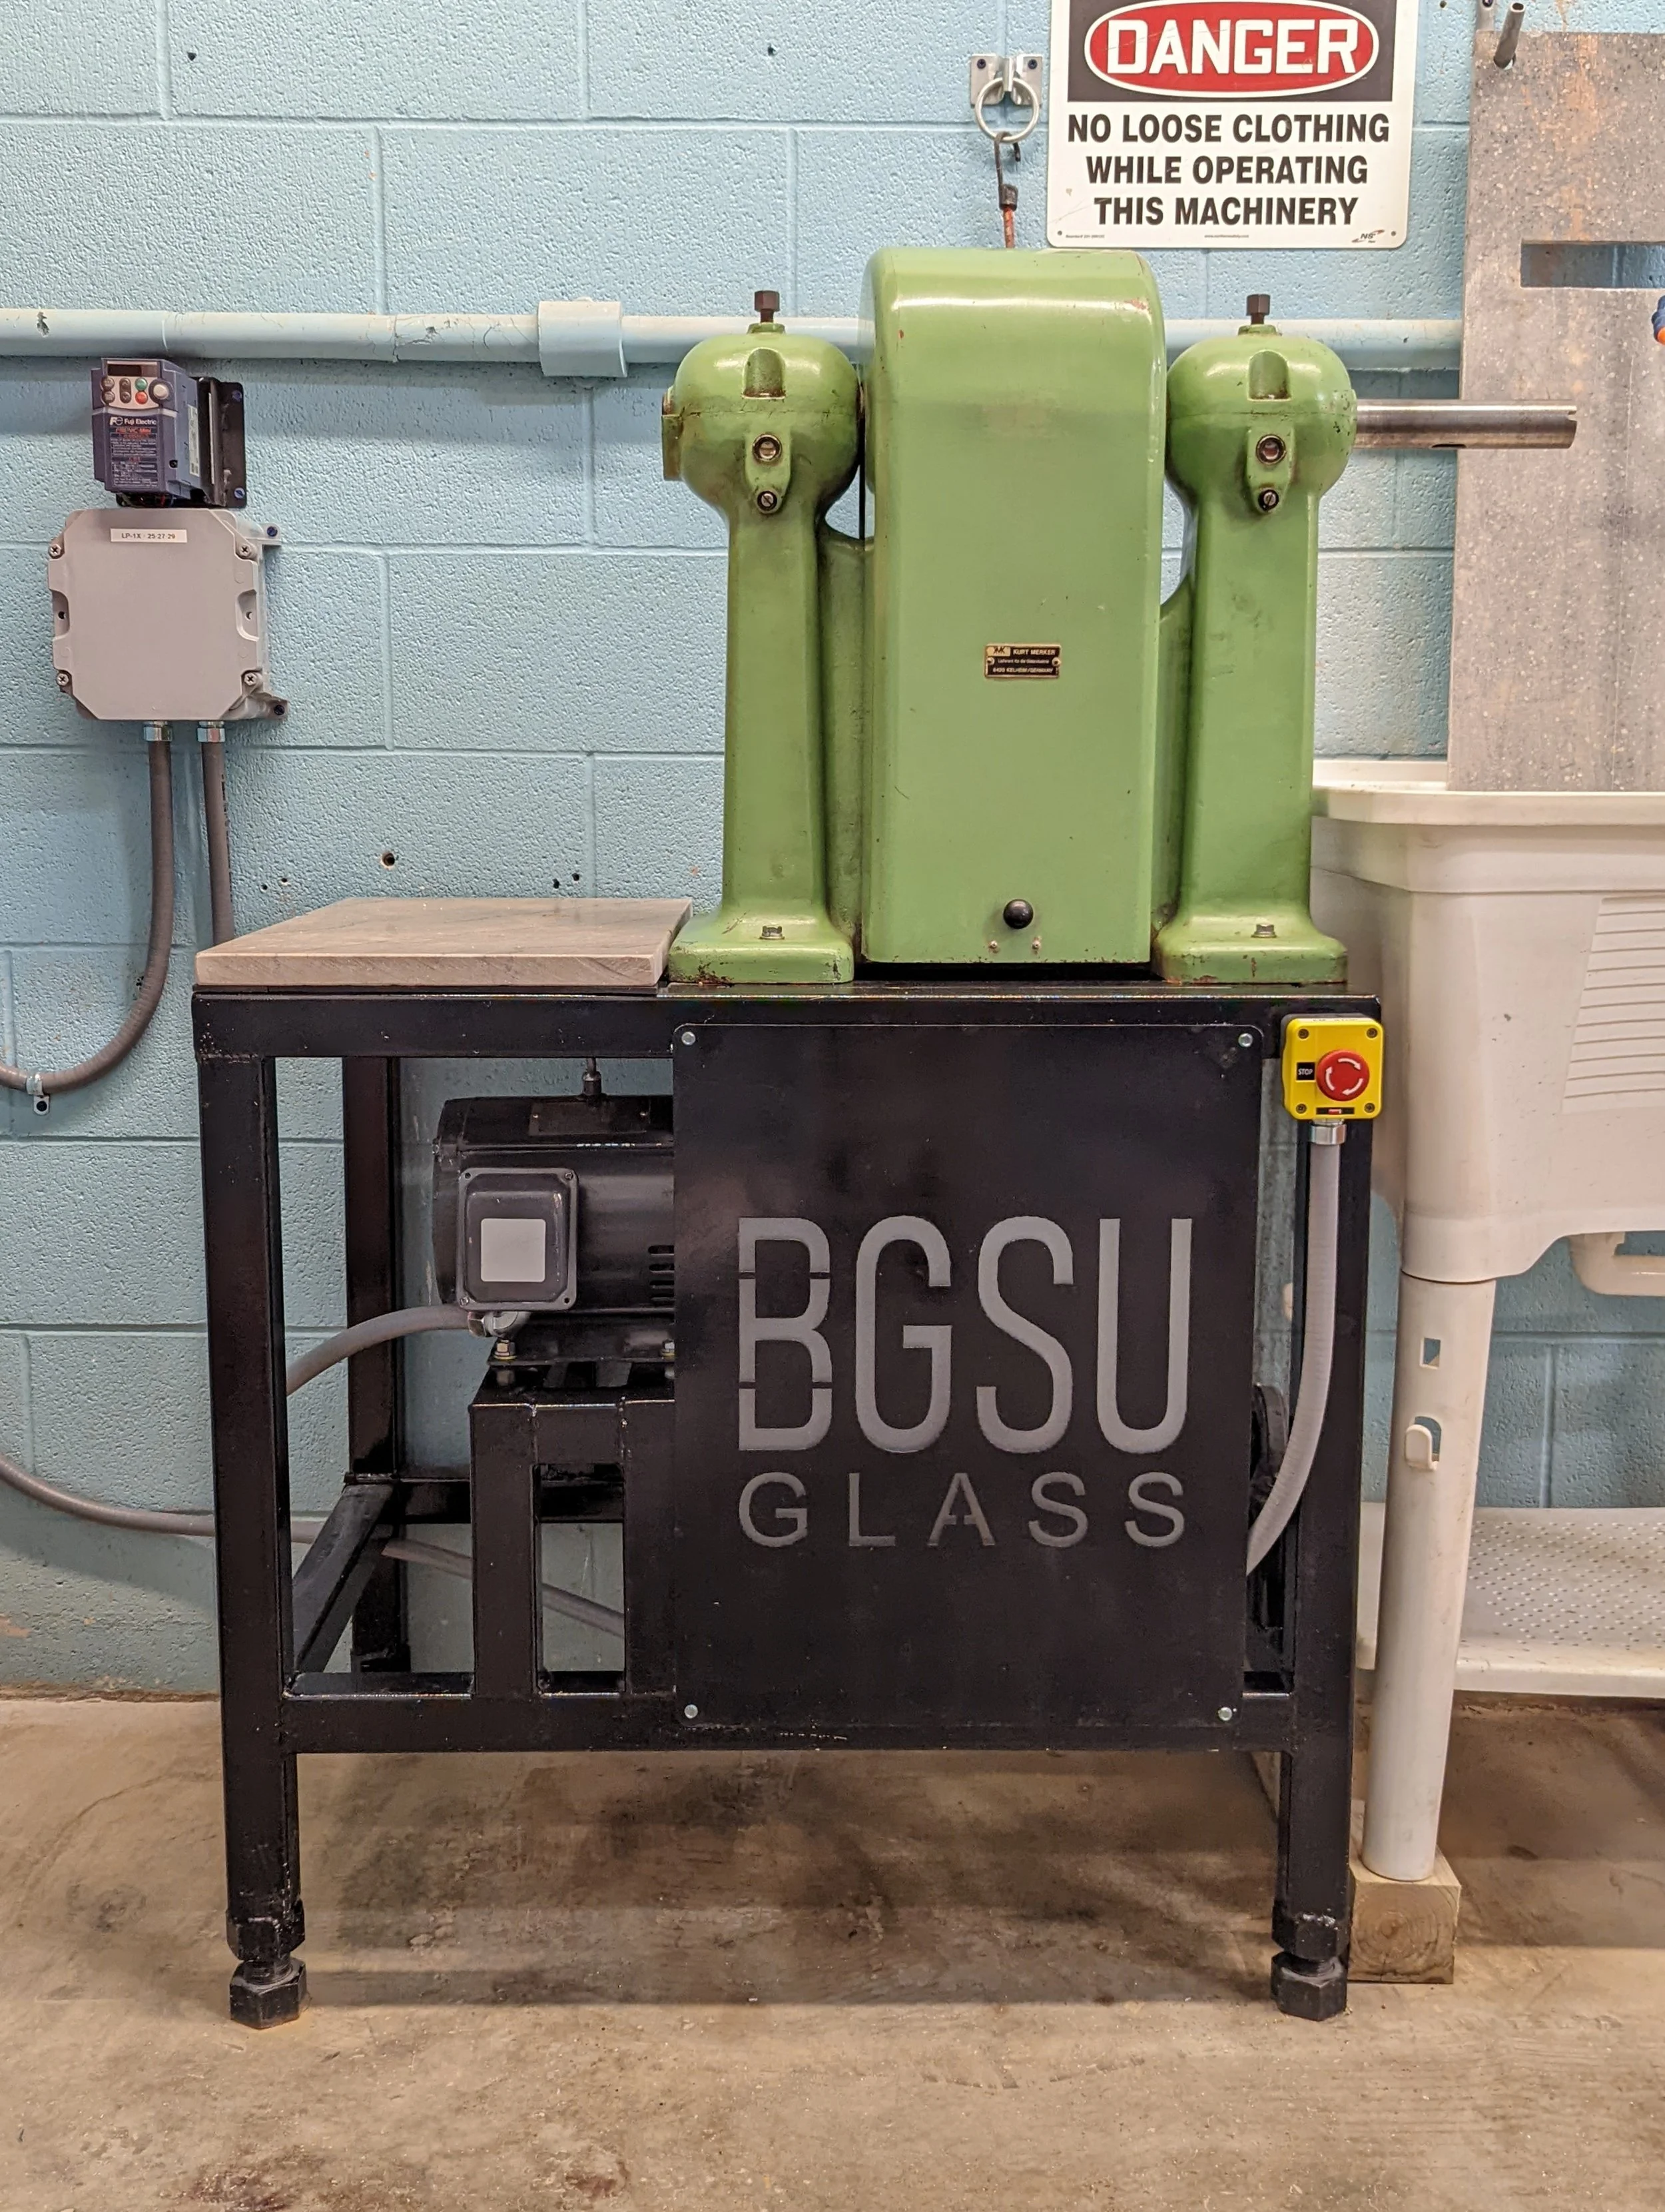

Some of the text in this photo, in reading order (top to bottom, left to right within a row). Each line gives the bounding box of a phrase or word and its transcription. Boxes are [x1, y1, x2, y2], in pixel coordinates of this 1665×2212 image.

[1106, 19, 1358, 75] DANGER
[1068, 113, 1389, 143] NO LOOSE CLOTHING
[1086, 155, 1367, 184] WHILE OPERATING
[1094, 196, 1358, 225] THIS MACHINERY
[738, 1215, 1192, 1453] BGSU
[738, 1471, 1185, 1548] GLASS
